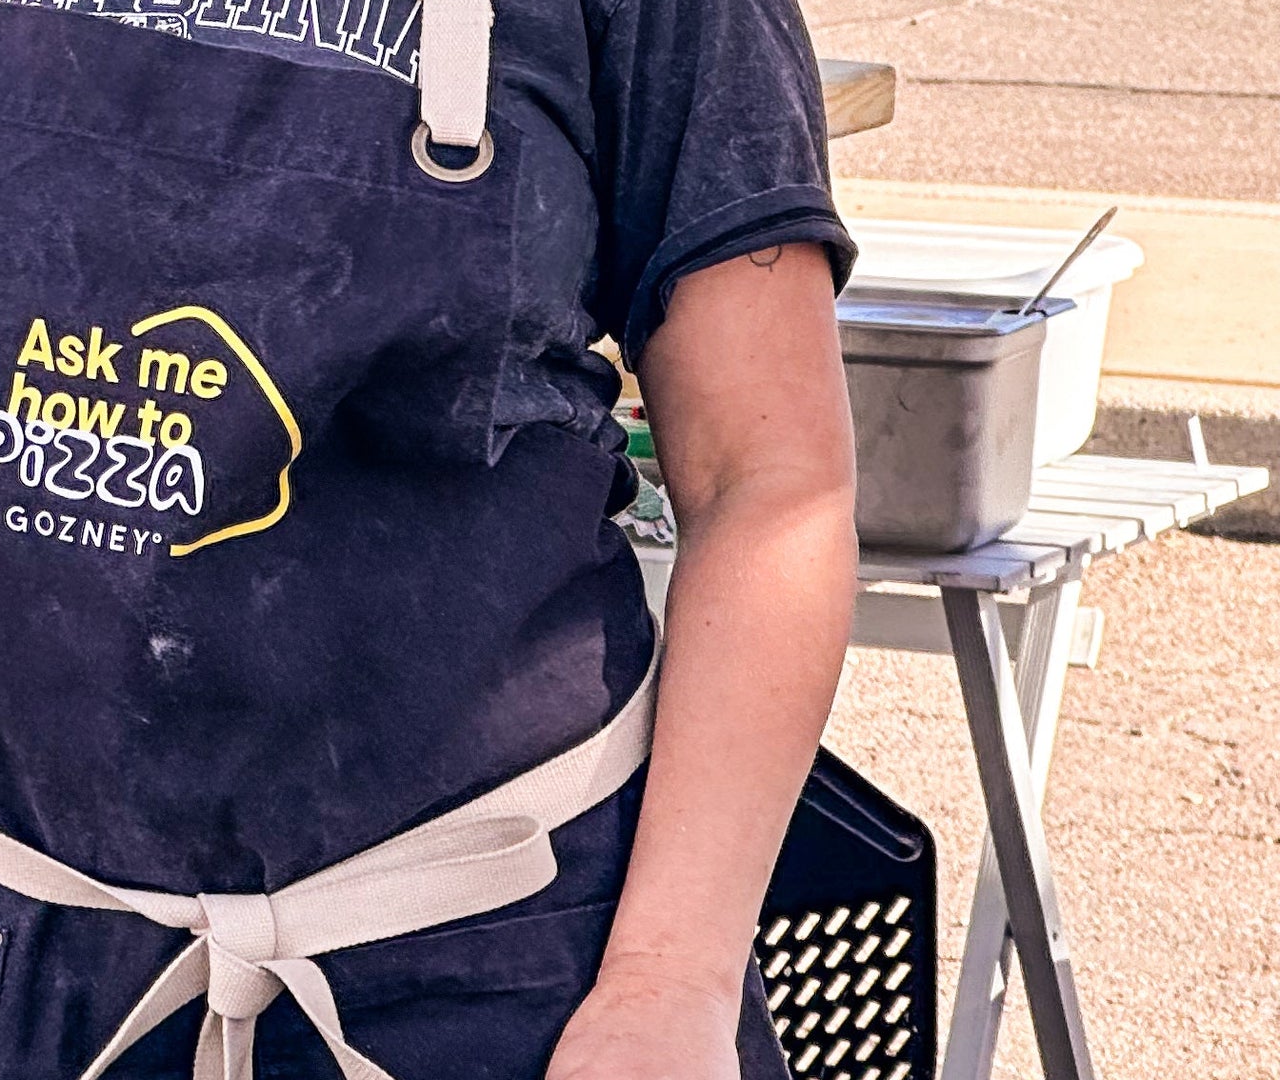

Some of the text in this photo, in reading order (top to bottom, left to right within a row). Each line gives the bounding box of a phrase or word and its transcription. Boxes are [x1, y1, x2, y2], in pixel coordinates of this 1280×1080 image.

[16, 318, 228, 400] Ask me
[8, 372, 193, 449] how to
